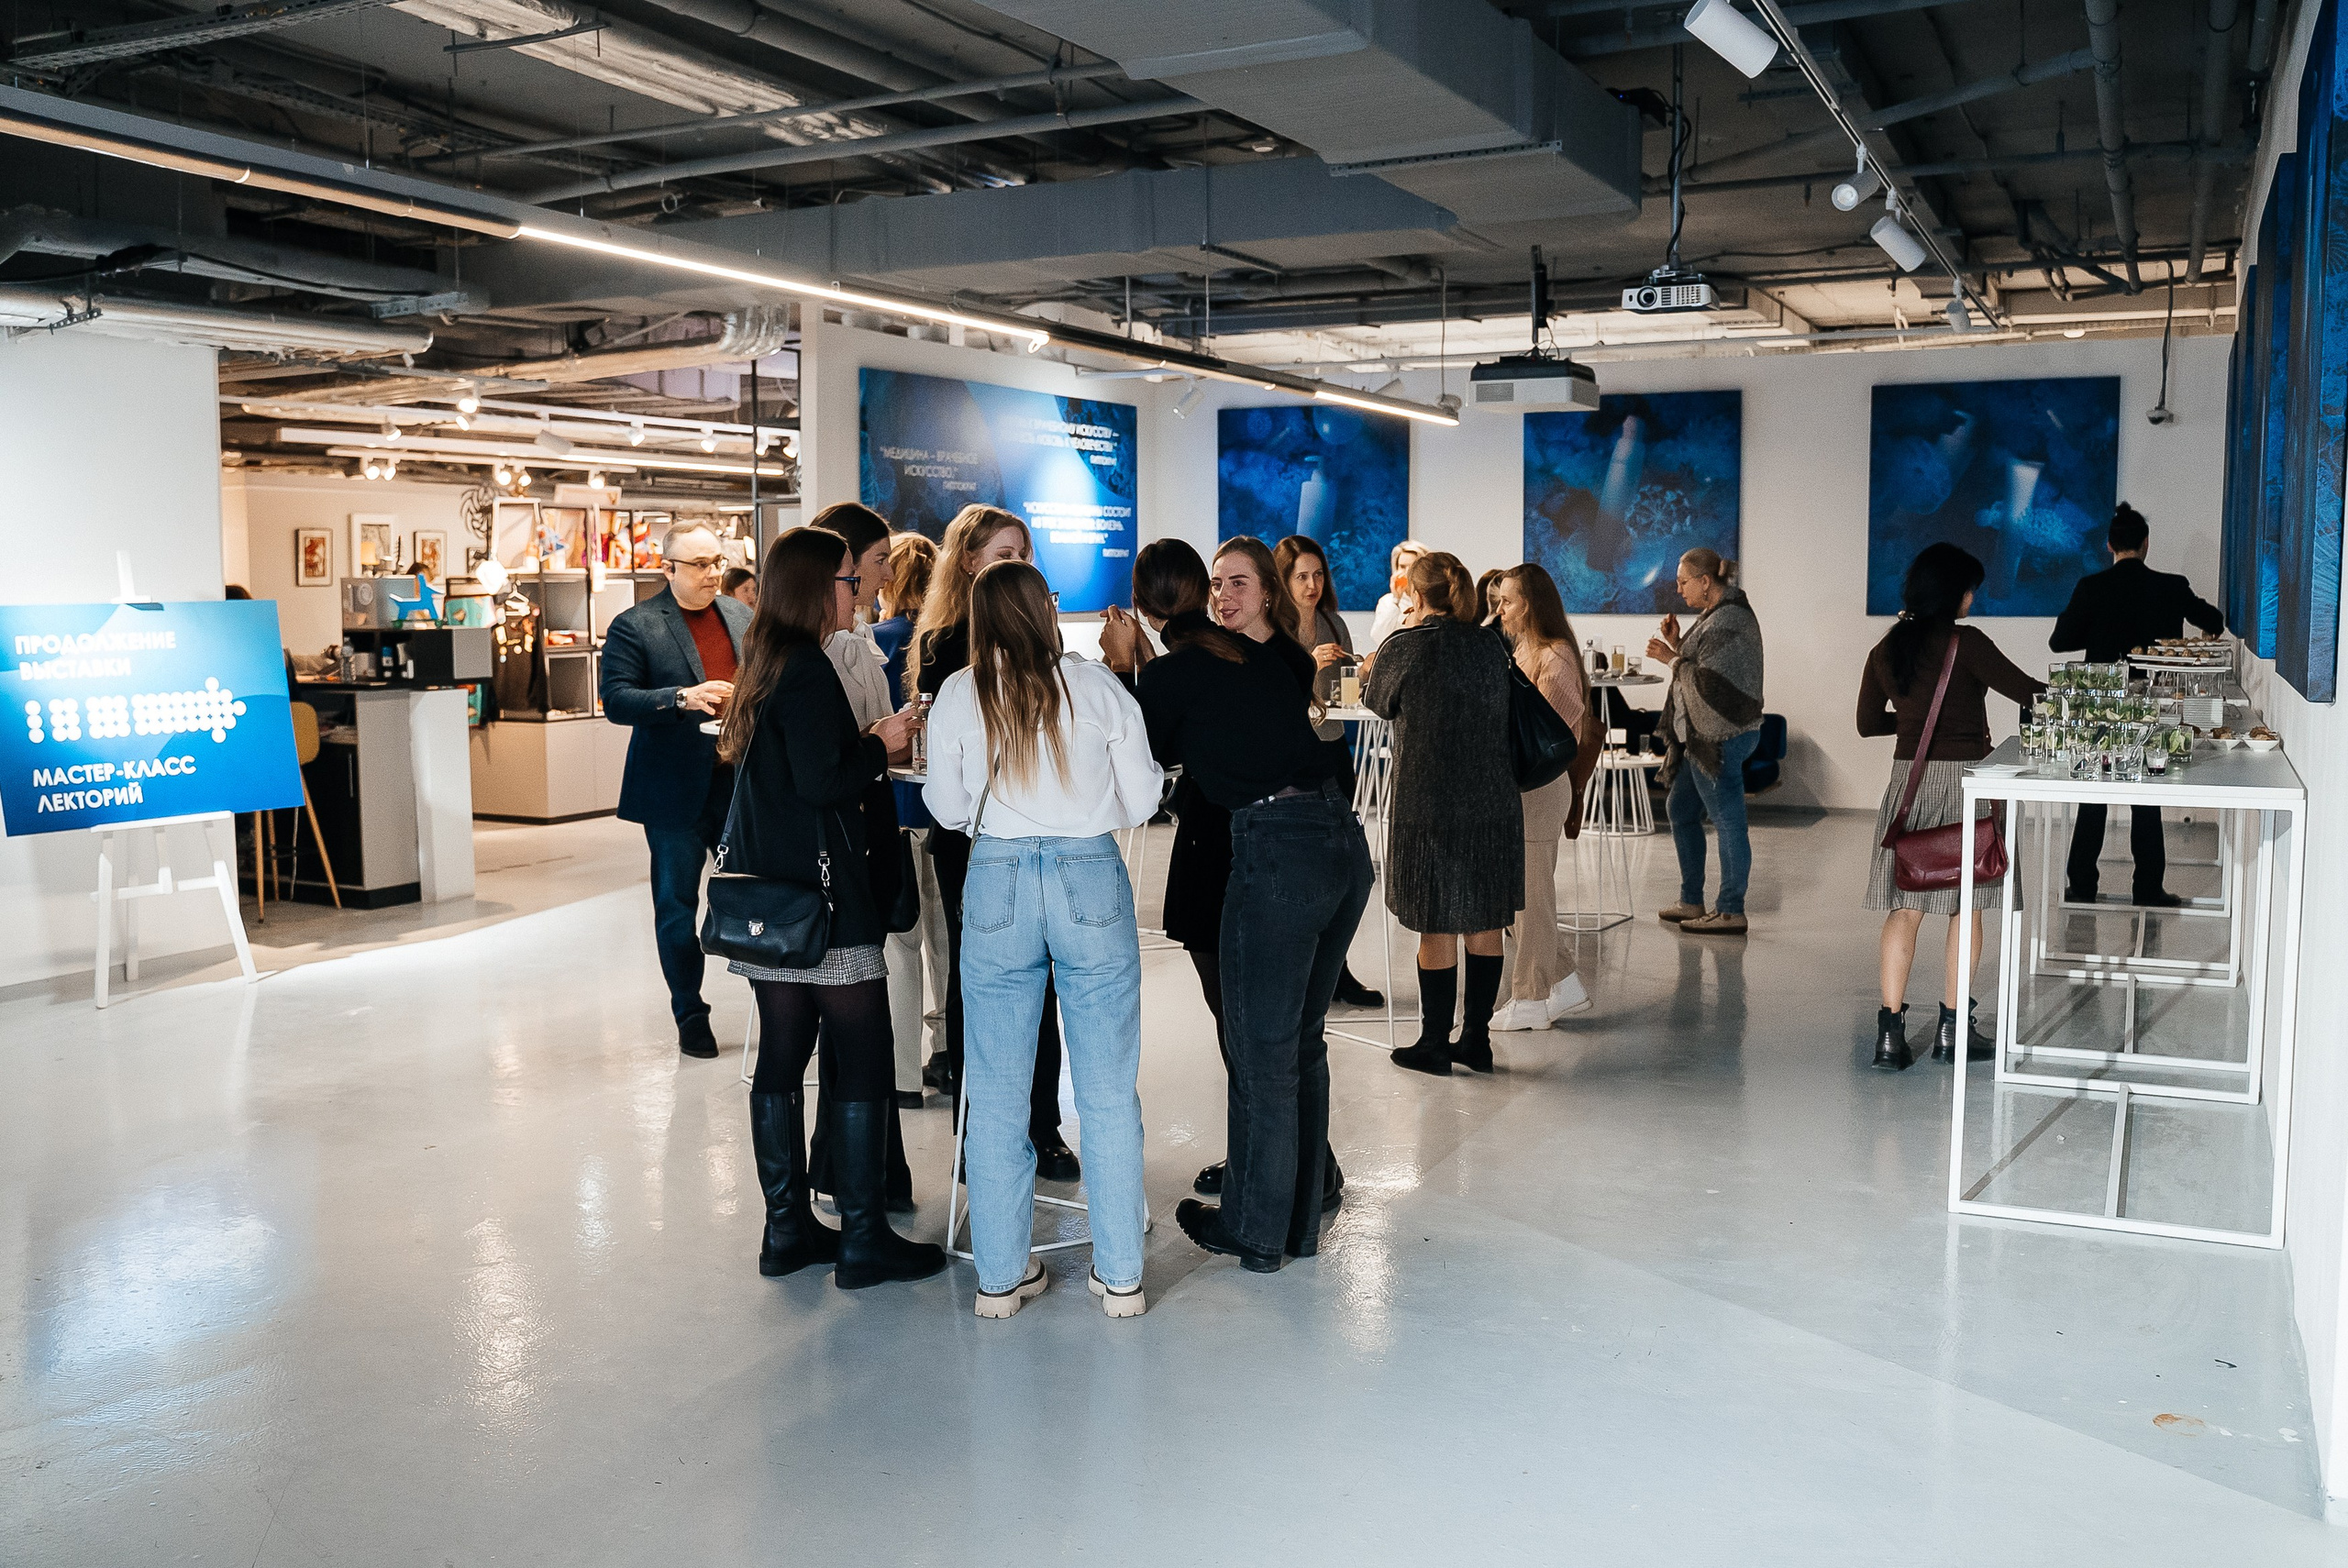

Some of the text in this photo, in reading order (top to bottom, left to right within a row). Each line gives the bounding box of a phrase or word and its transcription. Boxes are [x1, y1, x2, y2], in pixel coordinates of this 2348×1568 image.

[14, 631, 176, 655] ПРОДОЛЖЕНИЕ
[18, 657, 131, 680] ВЫСТАВКИ
[32, 755, 196, 788] МАСТЕР-КЛАСС
[38, 781, 143, 813] ЛЕКТОРИЙ
